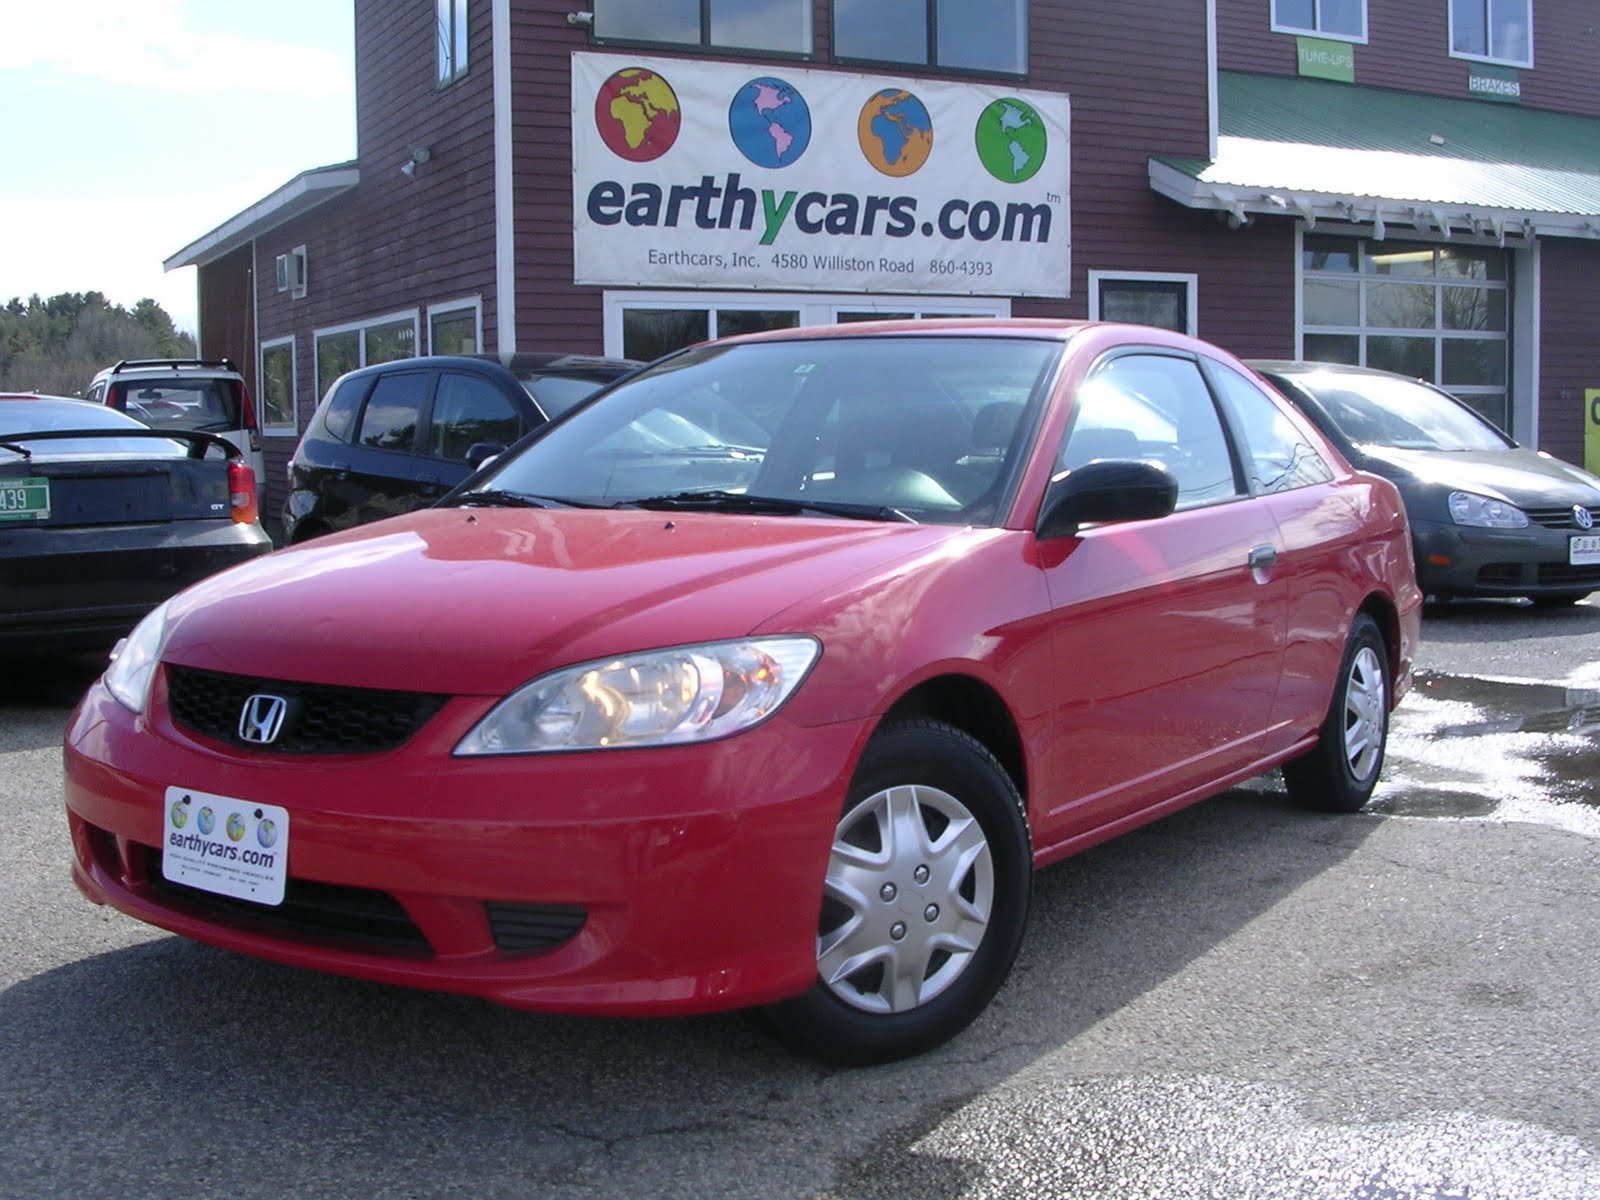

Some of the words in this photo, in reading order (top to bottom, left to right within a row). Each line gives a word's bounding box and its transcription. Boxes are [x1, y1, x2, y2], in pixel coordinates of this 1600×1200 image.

[1299, 49, 1353, 69] TUNE-UPS
[1470, 76, 1519, 96] BRAKES
[586, 173, 1053, 245] earthycars.com
[648, 248, 728, 270] Earthcars,
[732, 252, 760, 268] Inc.
[771, 253, 808, 269] 4580
[813, 255, 875, 272] Williston
[879, 257, 915, 273] Road
[929, 259, 993, 276] 860-4393
[169, 832, 275, 868] earthycars.com
